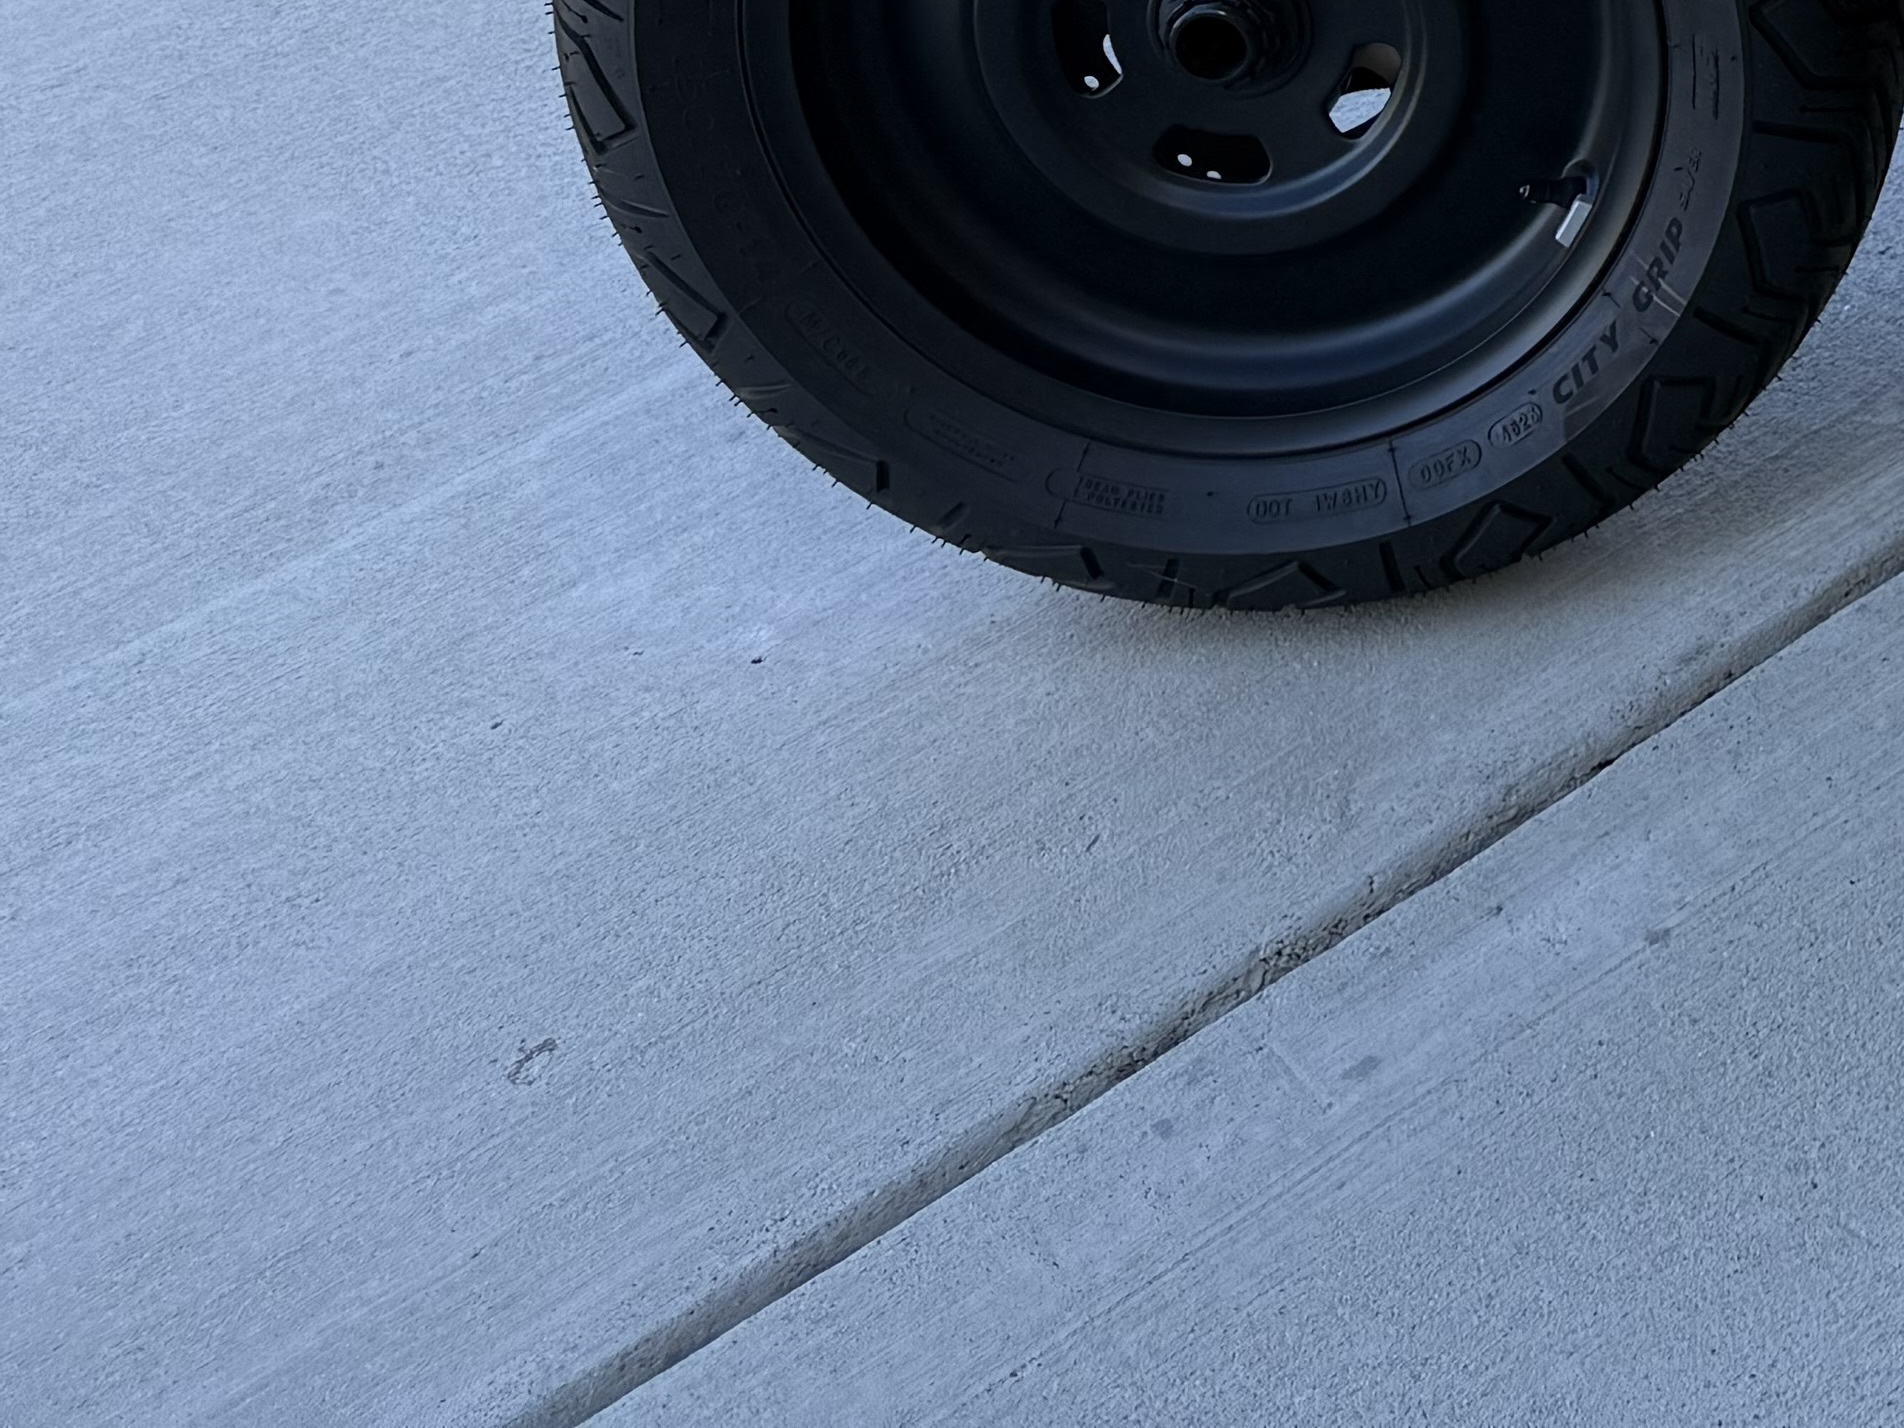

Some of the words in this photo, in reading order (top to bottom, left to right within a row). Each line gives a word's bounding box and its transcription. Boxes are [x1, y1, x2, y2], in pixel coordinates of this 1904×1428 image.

[1552, 318, 1619, 404] CITY
[1632, 217, 1683, 312] GRIP
[1255, 497, 1293, 518] DOT
